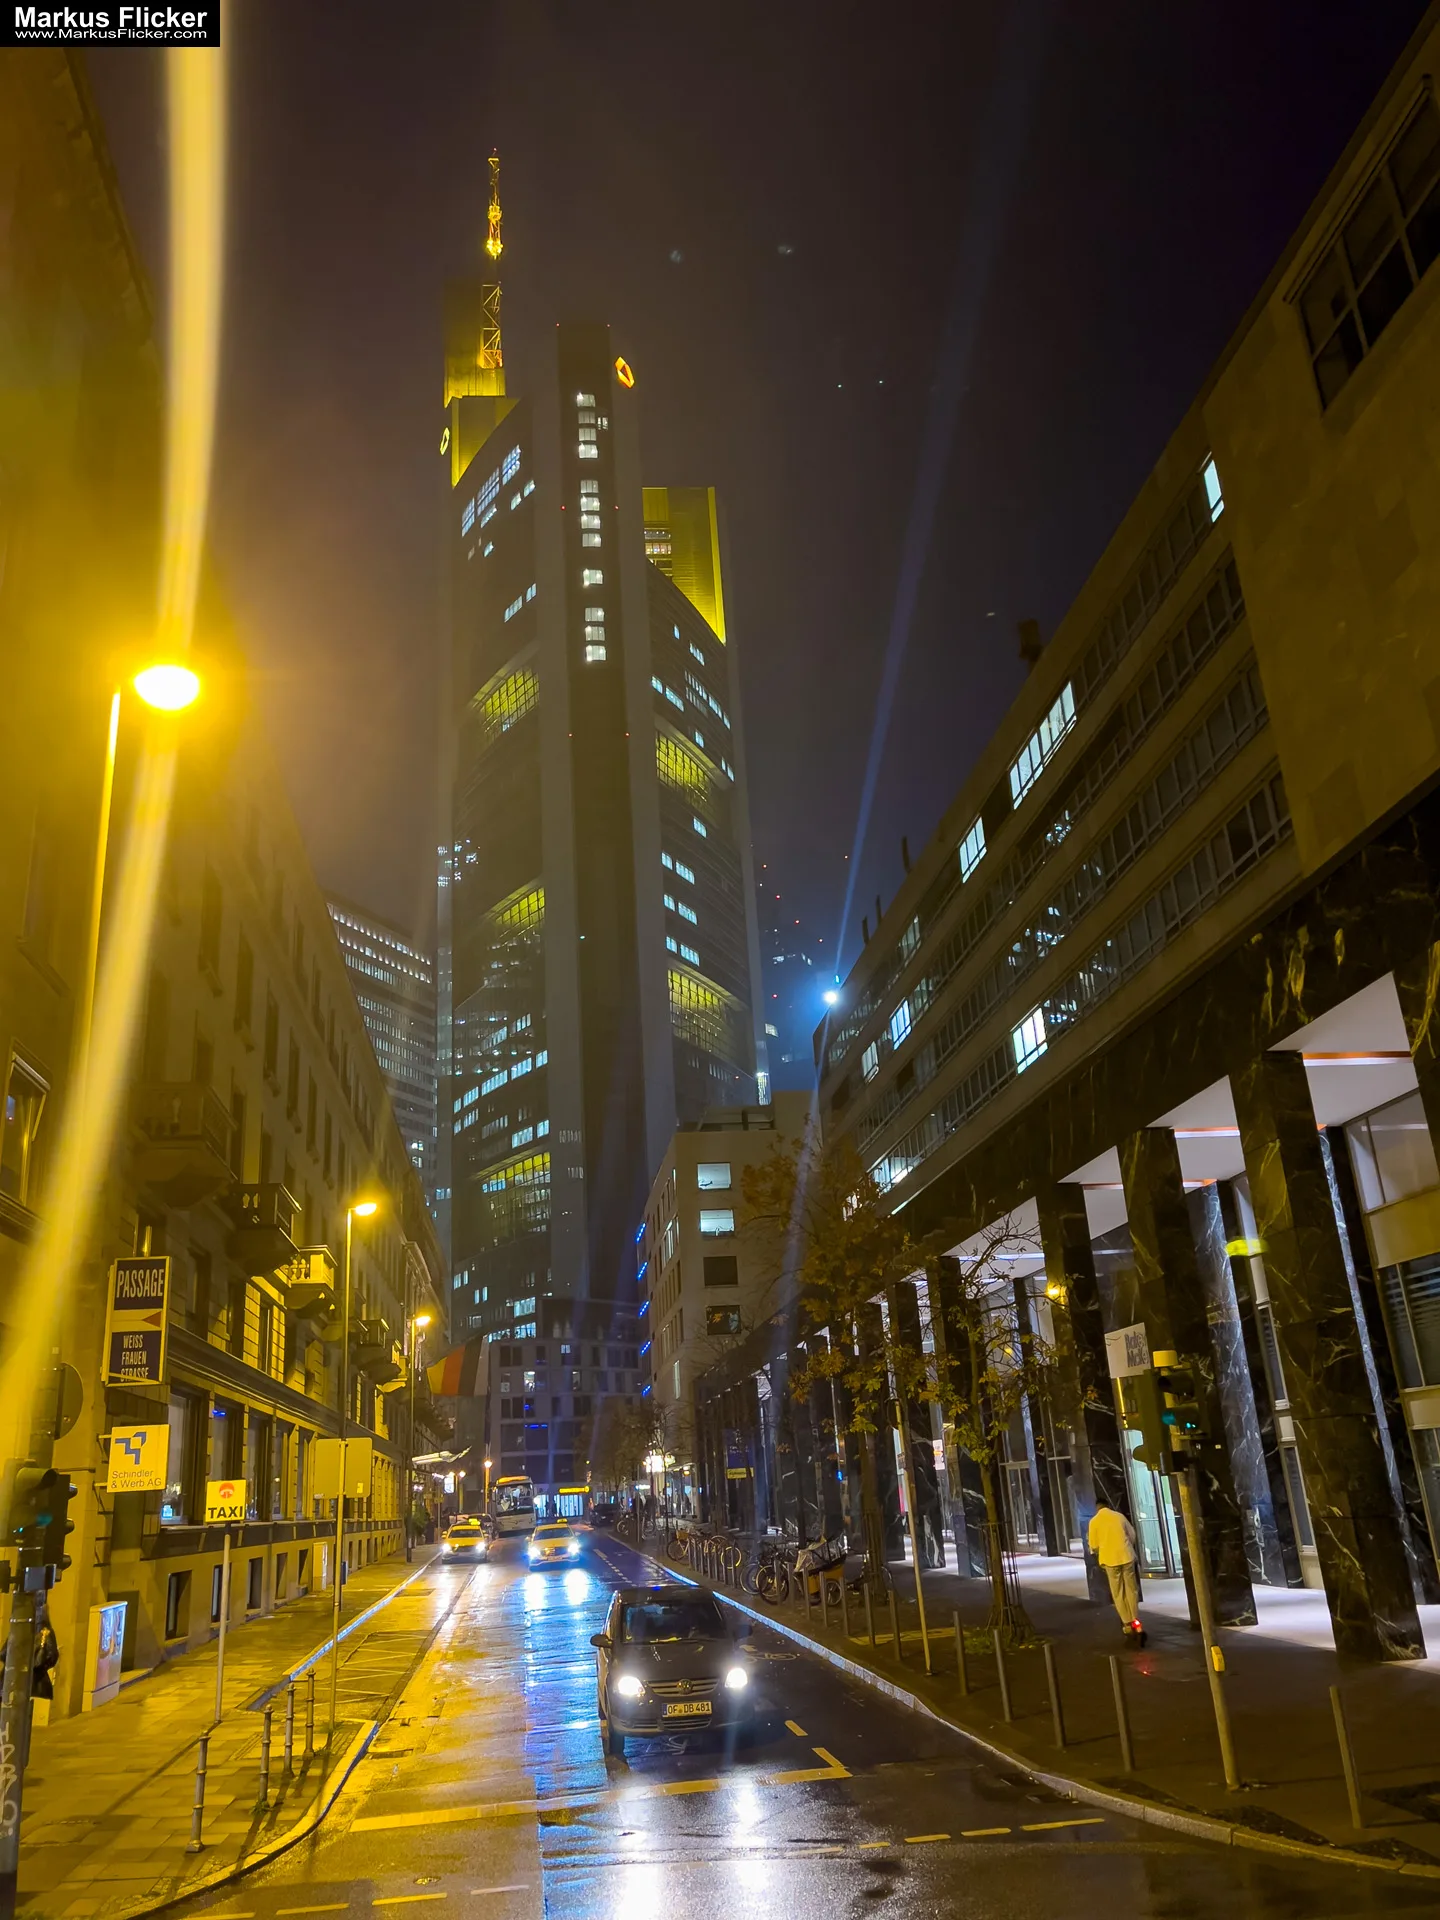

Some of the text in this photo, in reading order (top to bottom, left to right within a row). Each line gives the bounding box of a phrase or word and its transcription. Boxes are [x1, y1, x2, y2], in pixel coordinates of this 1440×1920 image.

[116, 1268, 164, 1298] PASSAGE
[123, 1334, 143, 1349] WEISS
[121, 1350, 147, 1366] FRAUEN
[111, 1470, 154, 1479] Schindler
[111, 1477, 161, 1489] & Werb AG
[208, 1506, 243, 1519] TAXI
[667, 1702, 710, 1714] OF DB 481
